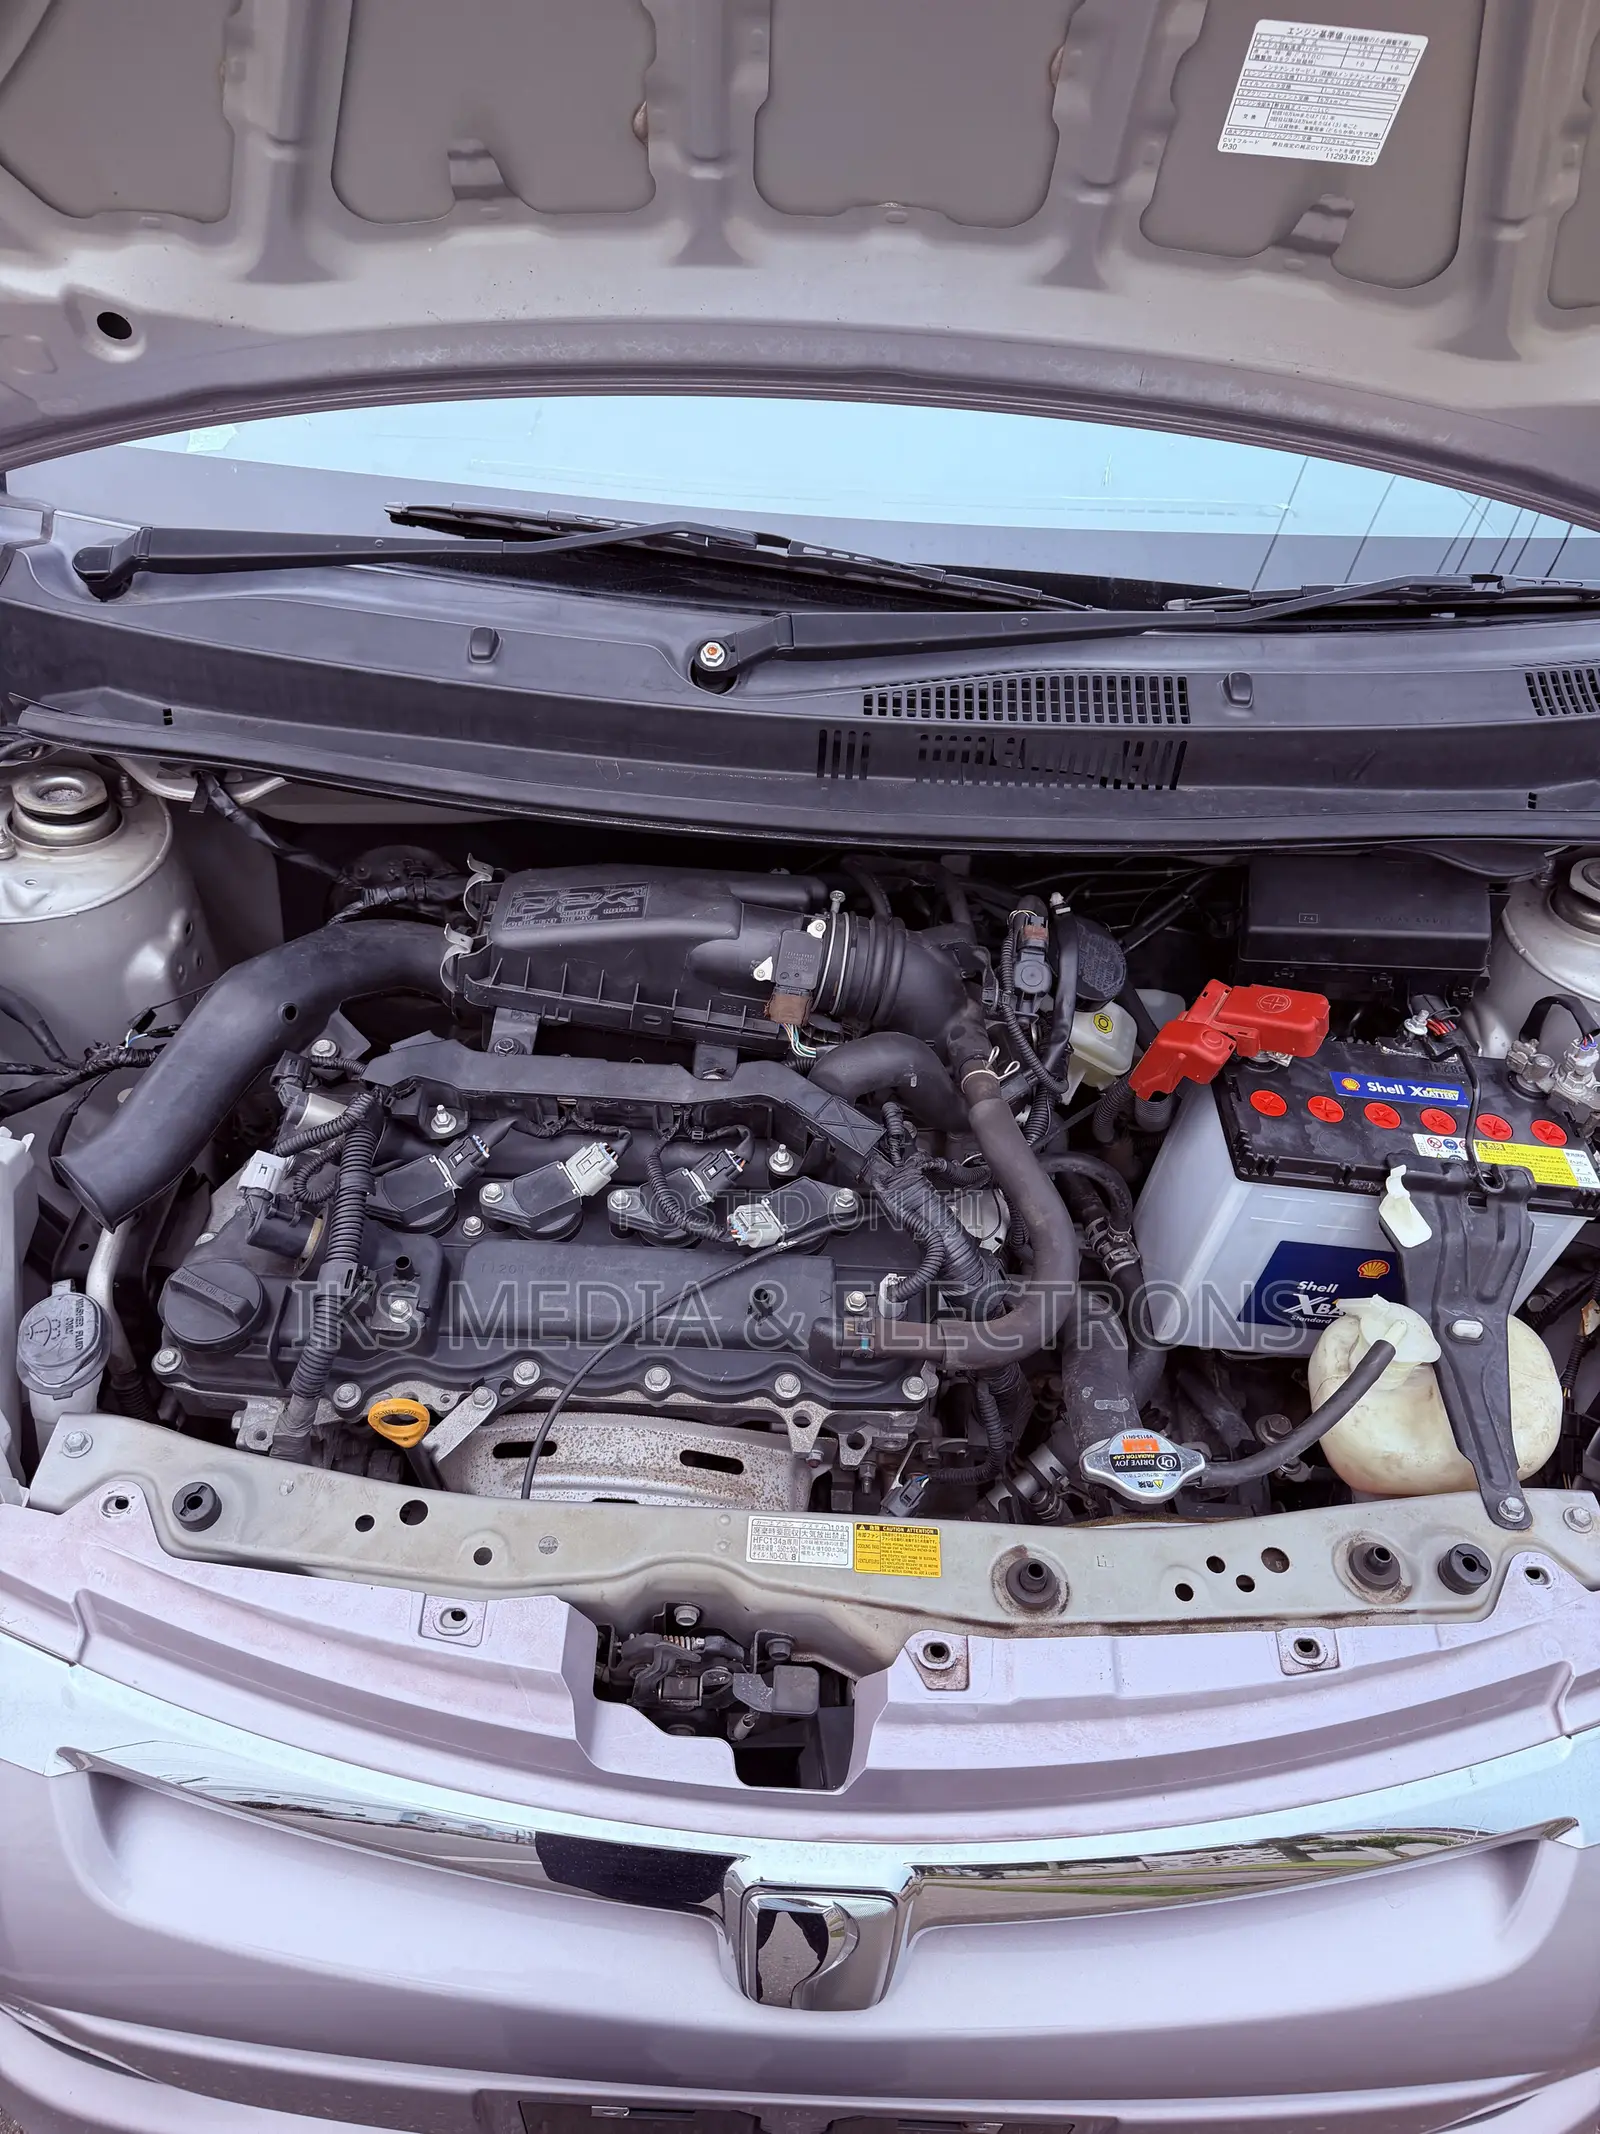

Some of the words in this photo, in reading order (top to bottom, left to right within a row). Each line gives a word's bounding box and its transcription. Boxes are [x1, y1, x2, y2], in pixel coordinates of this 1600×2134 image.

[1222, 143, 1238, 151] P30
[1325, 152, 1375, 163] 11293-B1221
[1366, 1082, 1405, 1096] Shell
[1297, 1280, 1339, 1293] Shell
[1290, 1314, 1332, 1324] Standard
[1115, 1459, 1130, 1467] JOY
[1130, 1459, 1155, 1467] DRIVE
